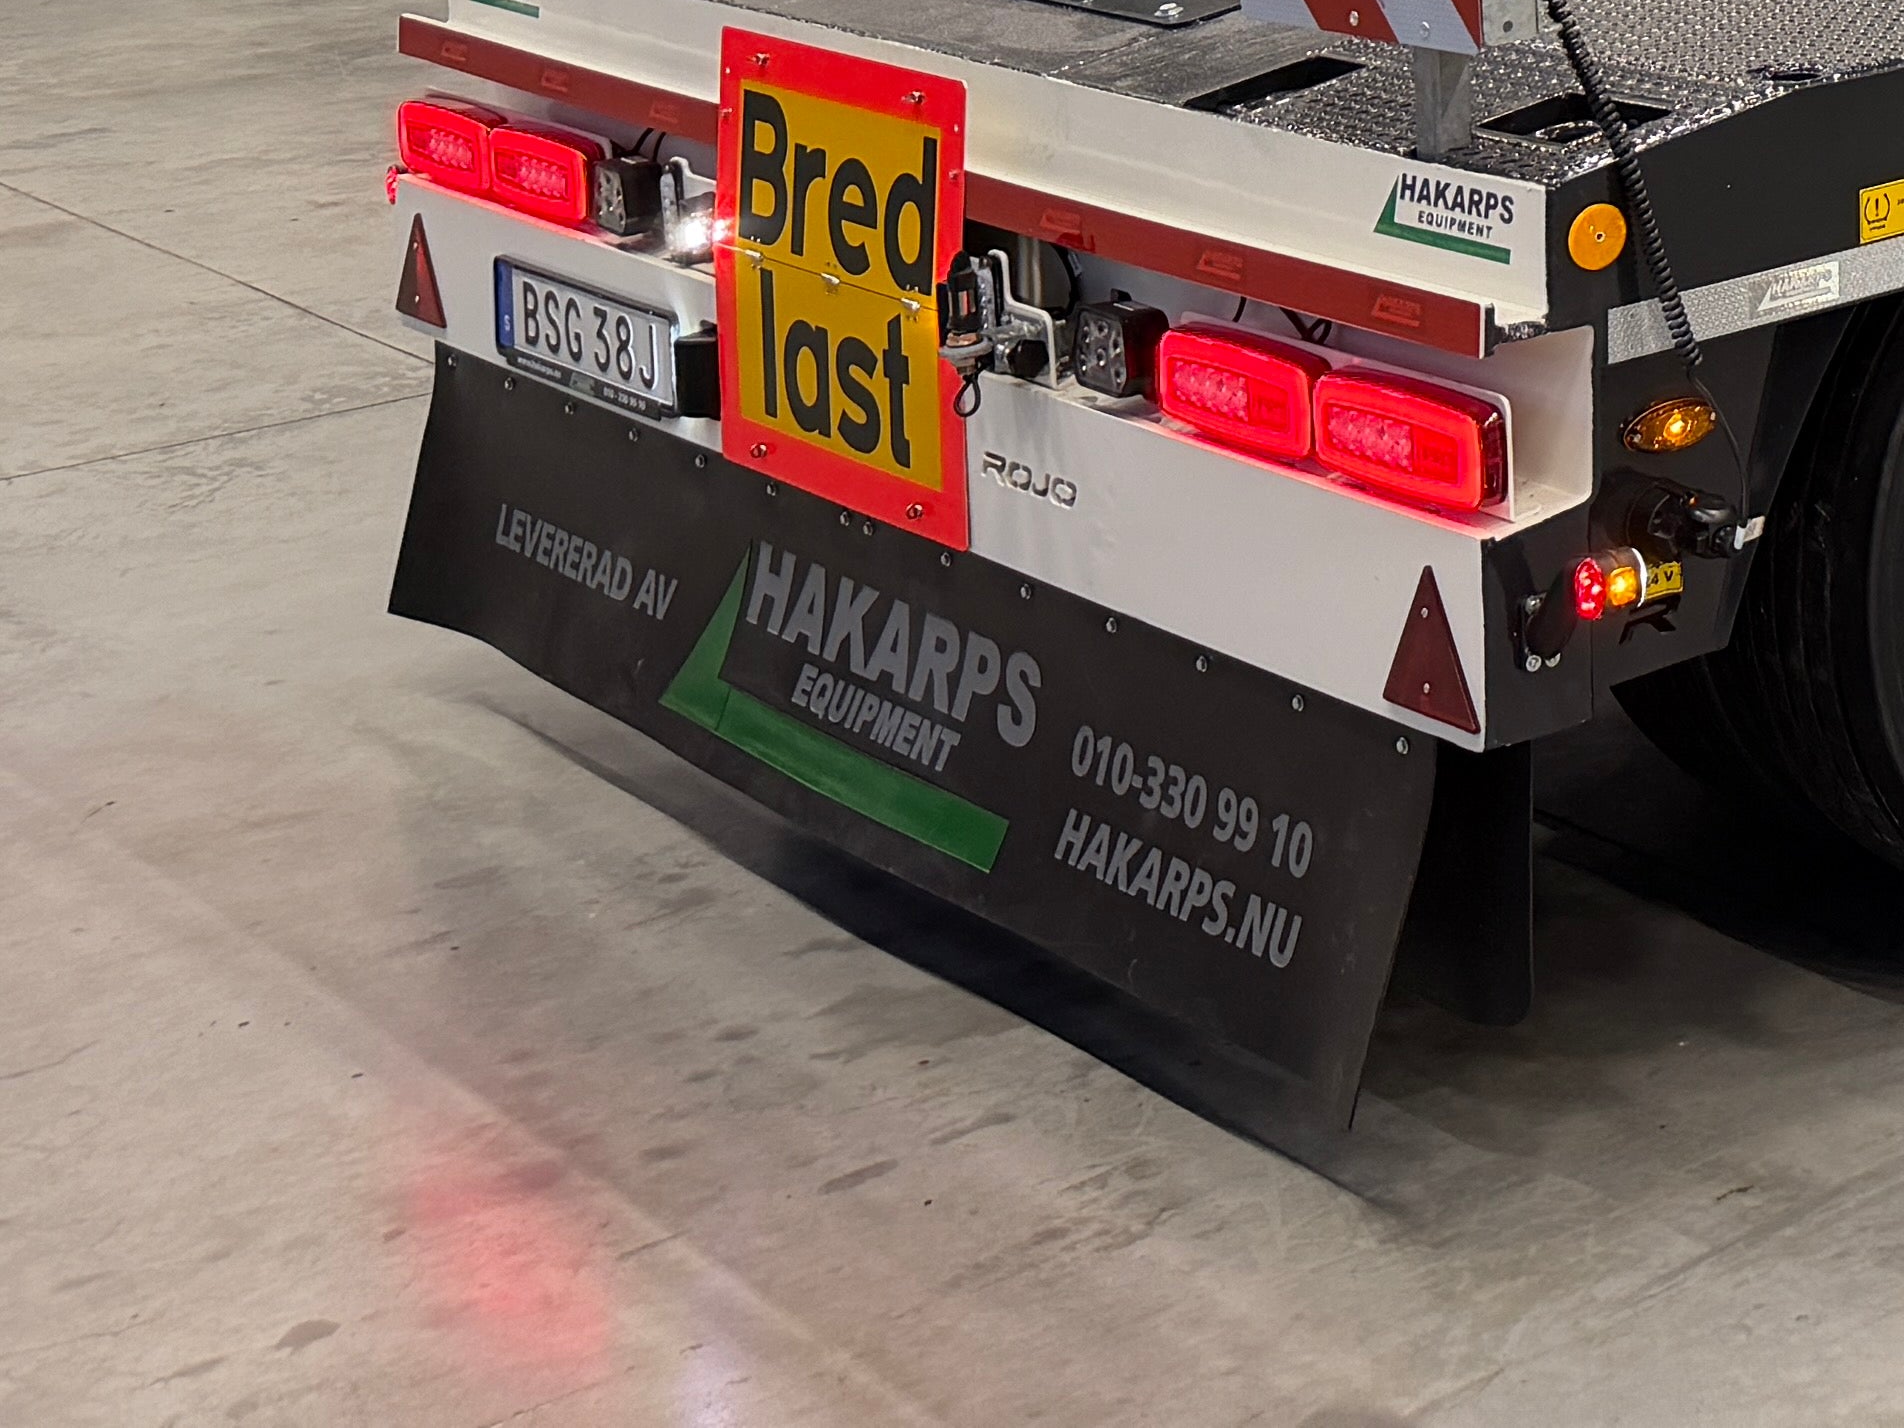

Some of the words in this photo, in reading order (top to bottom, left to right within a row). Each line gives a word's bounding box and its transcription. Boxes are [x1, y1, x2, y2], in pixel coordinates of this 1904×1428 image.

[740, 90, 938, 297] Bred
[1400, 171, 1515, 226] HAKARPS
[1416, 209, 1494, 240] EQUIPMENT
[504, 314, 511, 332] S
[522, 279, 583, 363] BSG
[593, 305, 659, 391] 38J
[758, 266, 913, 471] last
[980, 450, 1078, 510] ROJO
[497, 502, 633, 604] LEVERERAD
[637, 570, 679, 623] AV
[745, 542, 1043, 748] HAKARPS
[792, 662, 960, 772] EQUIPMENT
[1071, 725, 1207, 831] 010-330
[1214, 789, 1262, 852] 99
[1270, 814, 1314, 879] 10
[1054, 809, 1304, 970] HAKARPS.NU
